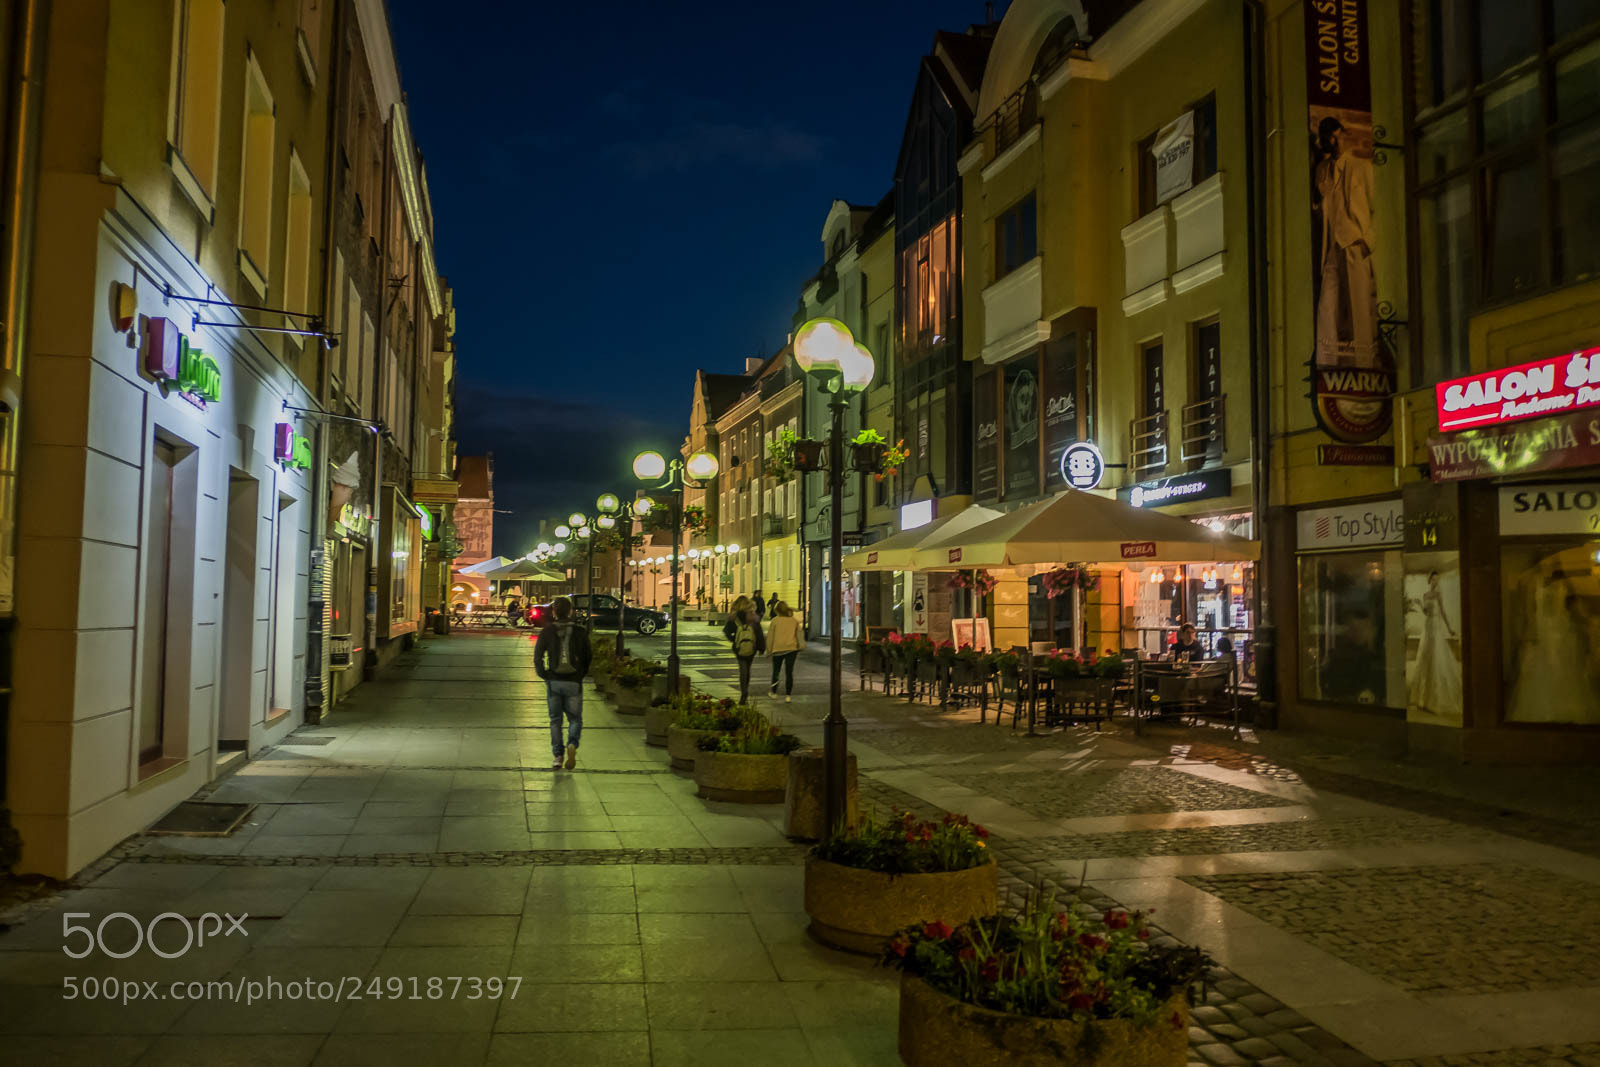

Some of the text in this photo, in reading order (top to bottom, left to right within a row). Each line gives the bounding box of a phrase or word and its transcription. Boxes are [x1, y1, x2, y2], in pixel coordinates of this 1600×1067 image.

[1317, 18, 1340, 95] SALON
[1208, 347, 1217, 442] TATTOO
[1322, 370, 1392, 393] WARKA
[1443, 363, 1555, 413] SALON
[1513, 490, 1598, 513] SALO
[1334, 516, 1360, 543] Top
[1364, 510, 1406, 542] Style
[1422, 526, 1438, 547] 14
